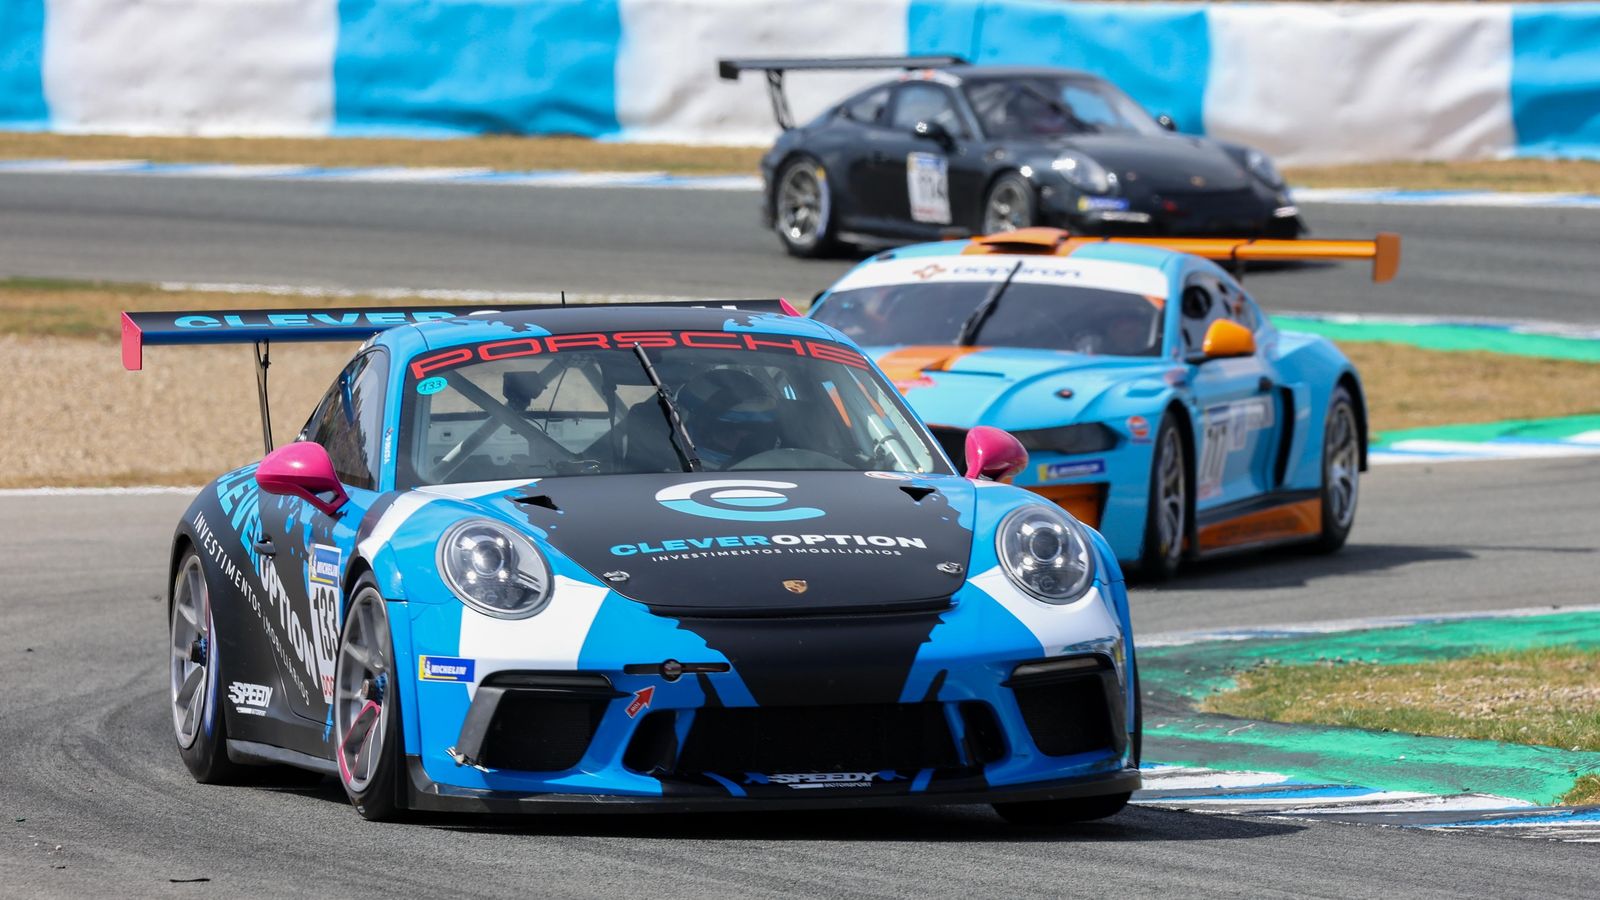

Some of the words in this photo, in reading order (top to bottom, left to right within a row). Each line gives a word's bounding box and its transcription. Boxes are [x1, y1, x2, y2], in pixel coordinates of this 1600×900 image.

[410, 330, 870, 380] PORSCHE
[421, 380, 443, 391] 133
[609, 533, 928, 557] CLEVEROPTION
[651, 548, 782, 562] INVESTIMENTOS
[788, 547, 903, 557] IMOBILIÁRIOS
[193, 510, 262, 619] INVESTIMENTOS
[431, 664, 467, 676] MICHELIN
[228, 681, 274, 708] SPEEDY
[767, 772, 880, 783] SPEEDY
